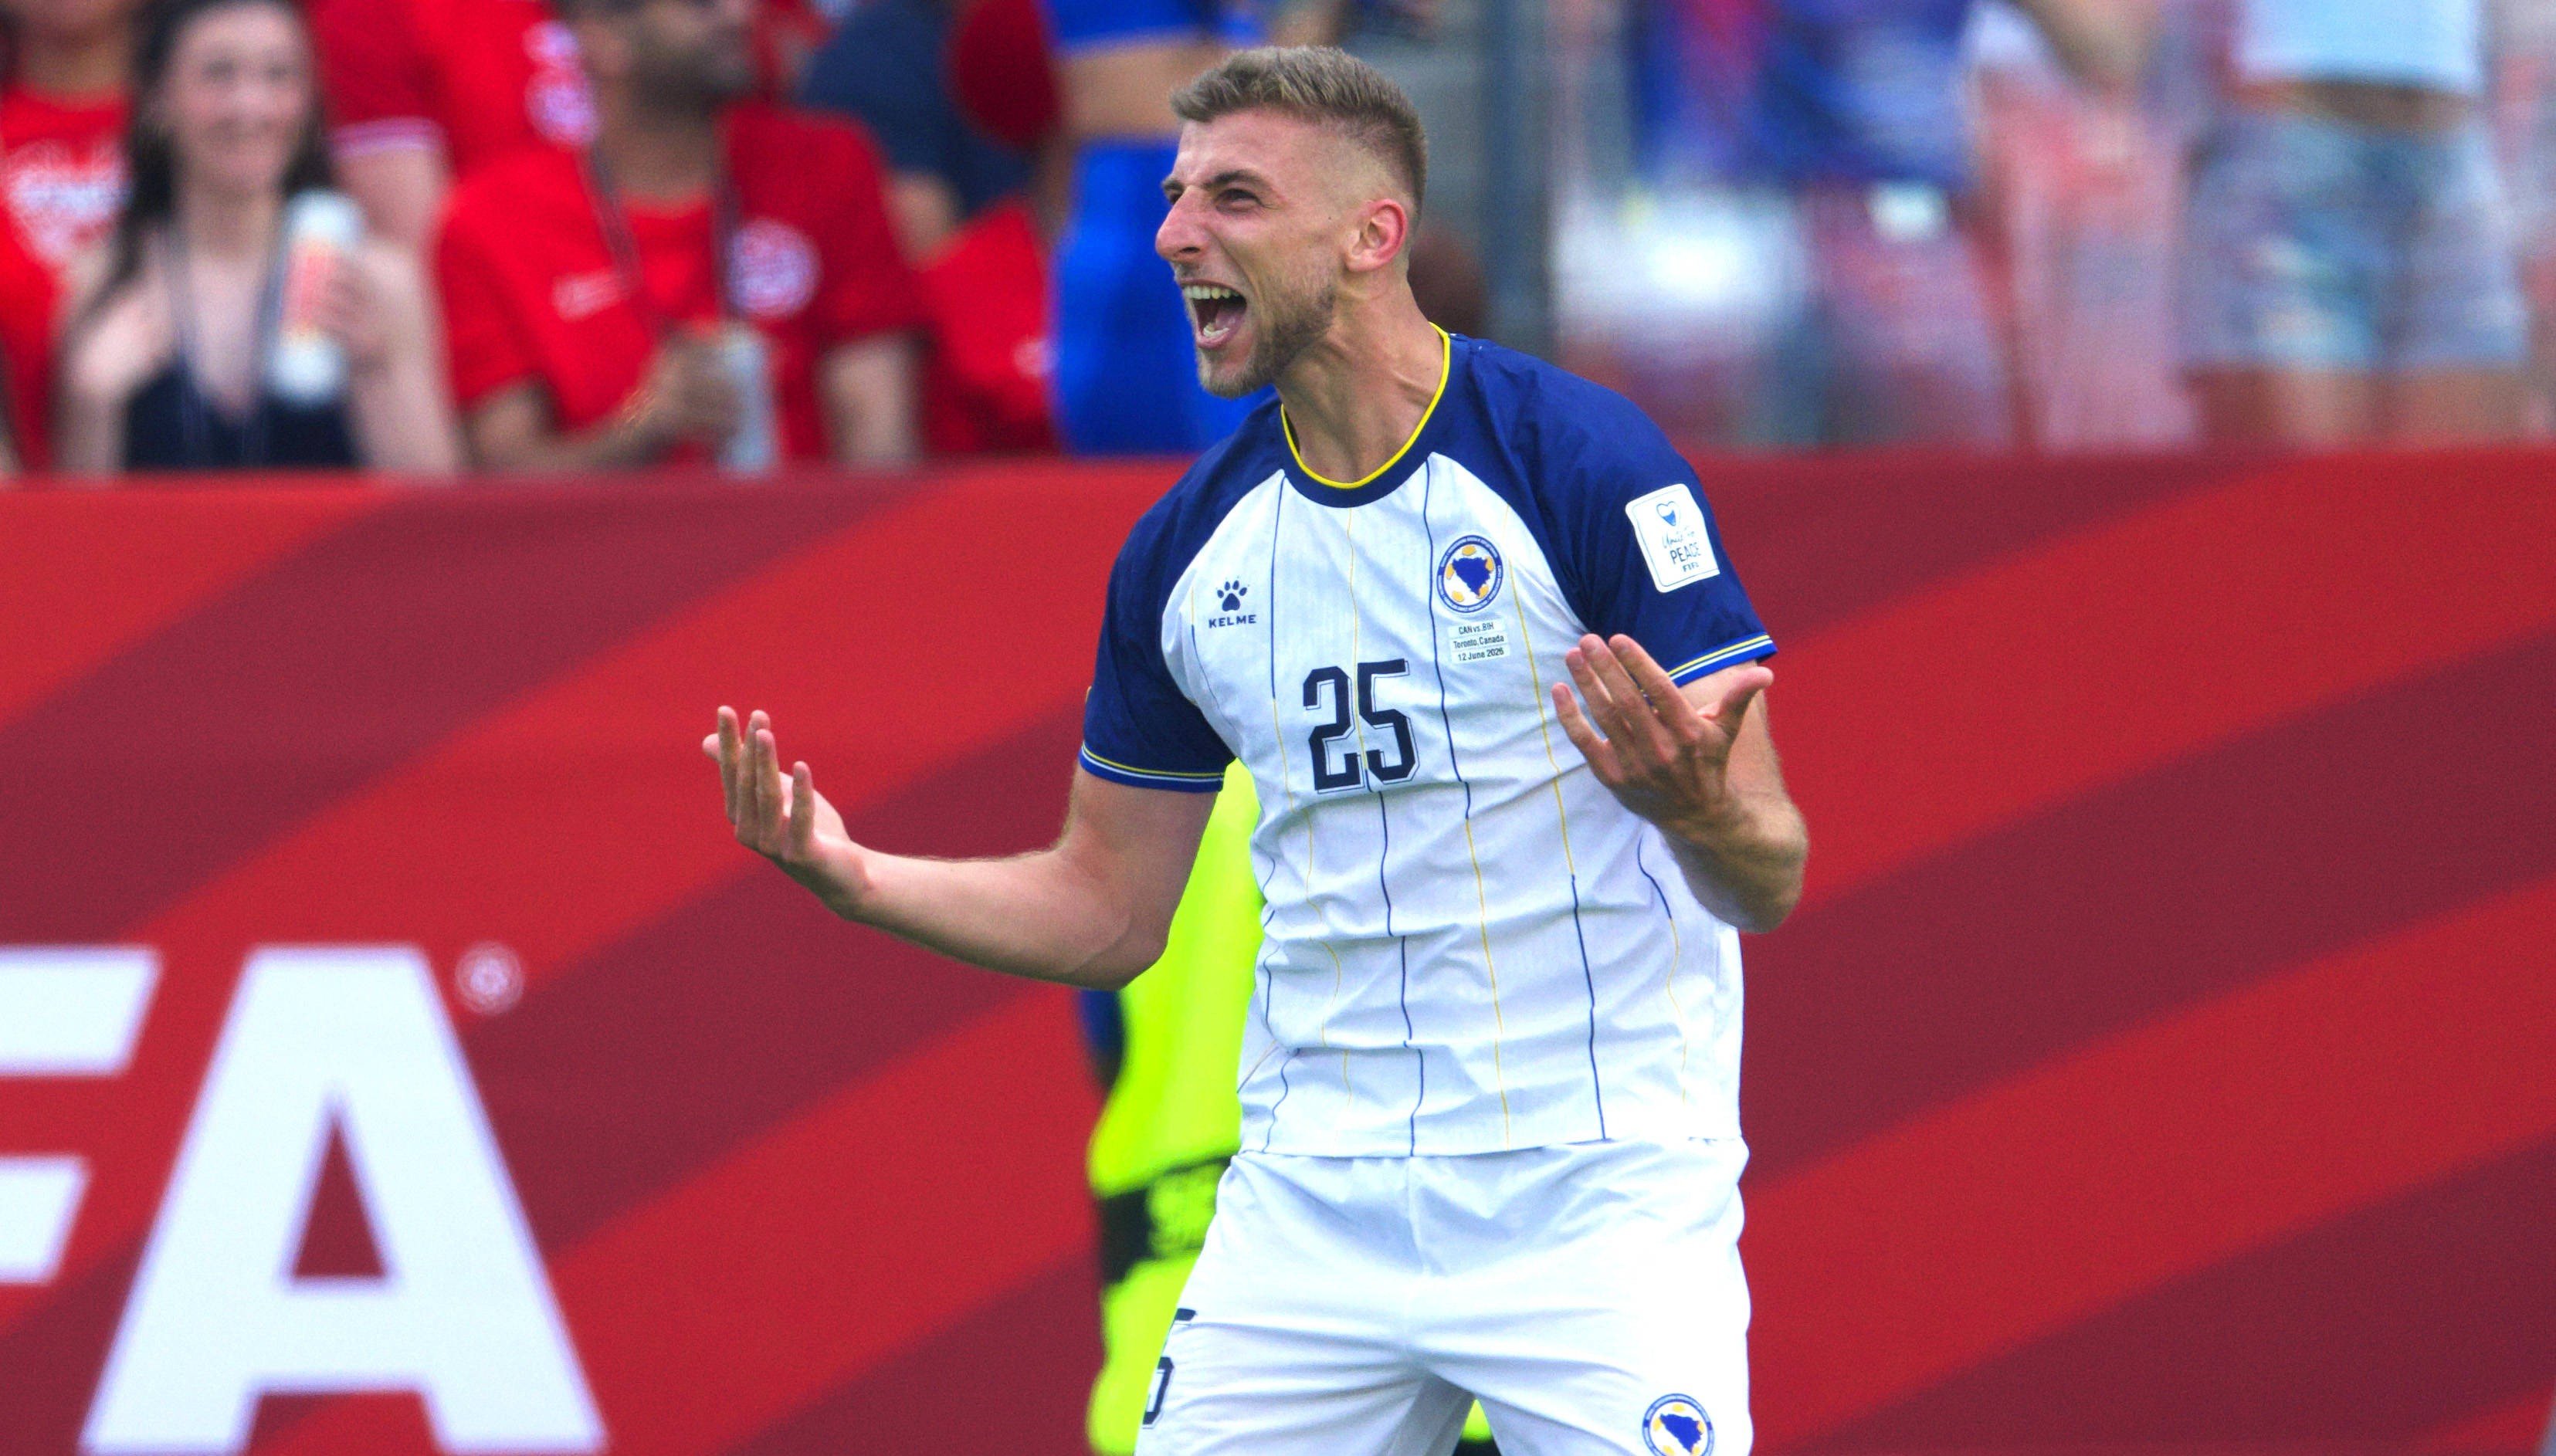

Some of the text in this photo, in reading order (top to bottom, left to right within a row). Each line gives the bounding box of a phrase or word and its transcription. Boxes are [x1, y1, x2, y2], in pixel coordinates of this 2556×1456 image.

[1209, 615, 1256, 628] KELME
[1459, 625, 1473, 635] CAN
[1482, 622, 1494, 631] BIH
[1453, 635, 1504, 648] Toronto, Canada
[1458, 652, 1466, 661] 12
[1468, 652, 1485, 660] June
[1303, 658, 1421, 795] 25
